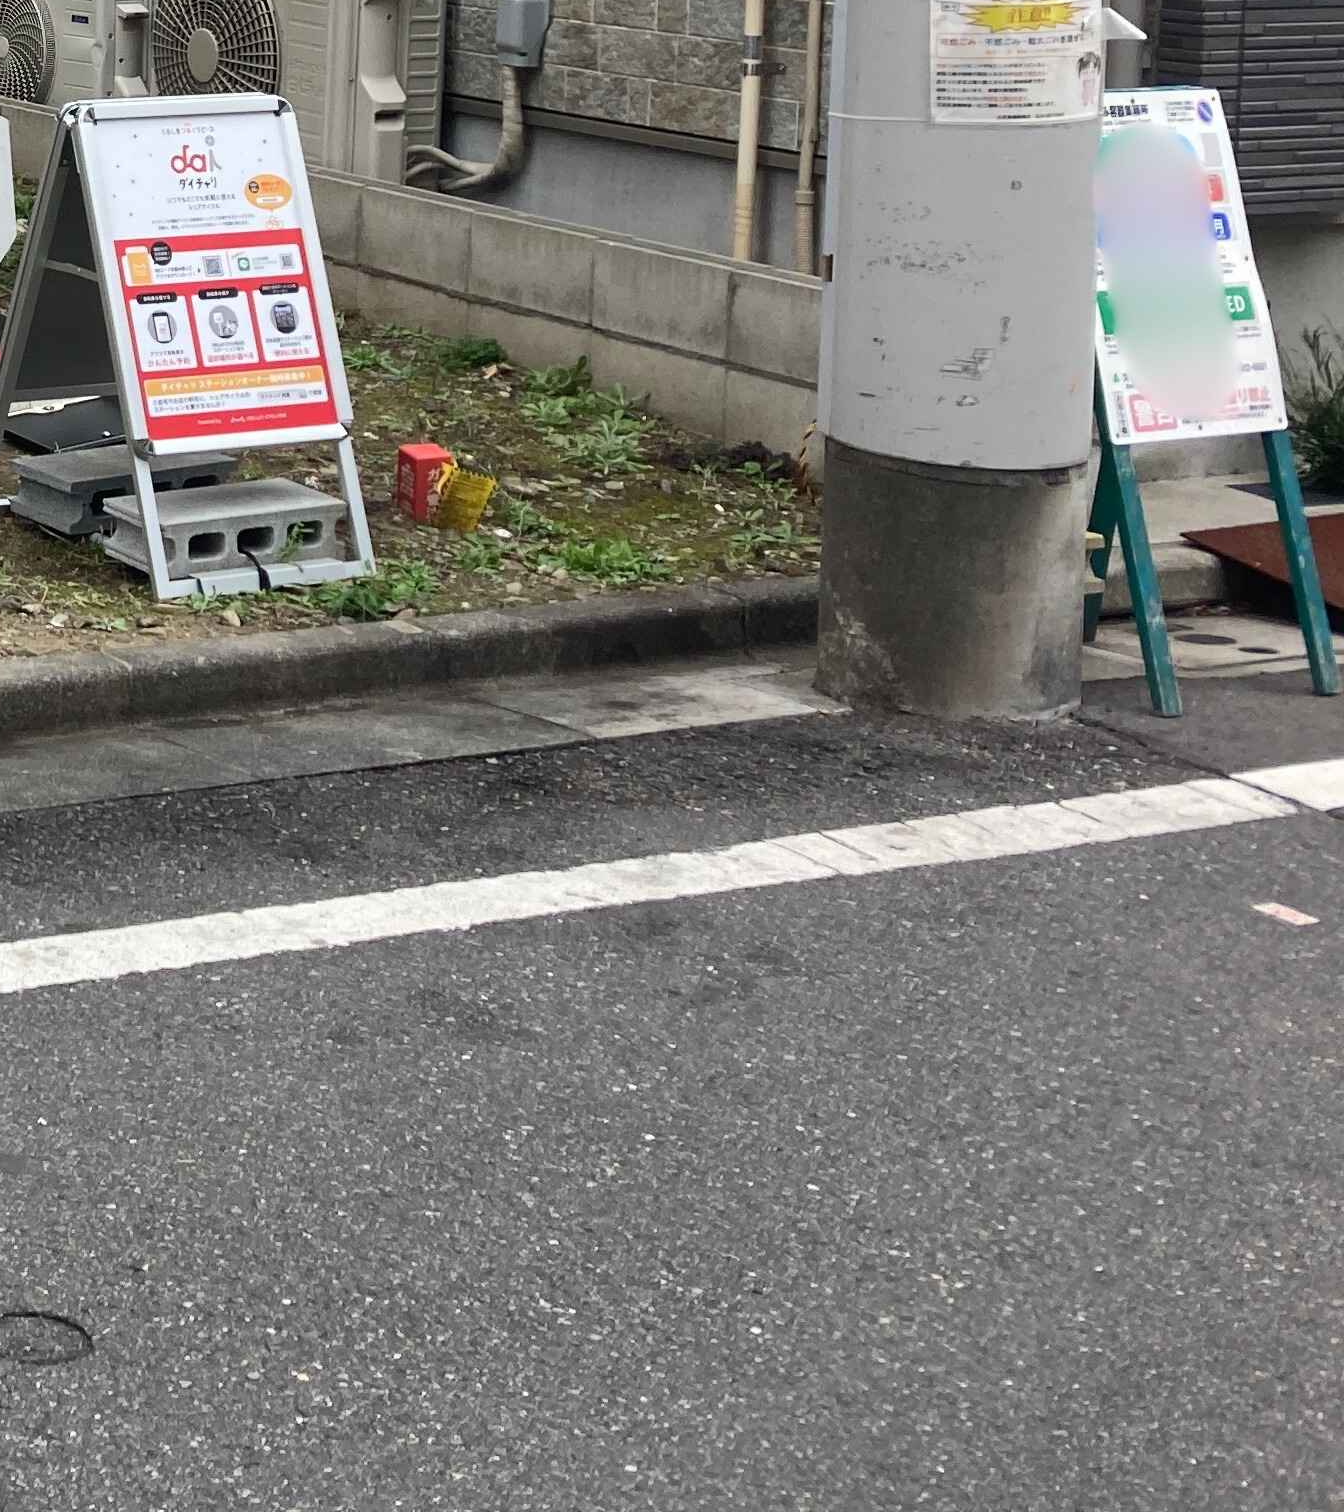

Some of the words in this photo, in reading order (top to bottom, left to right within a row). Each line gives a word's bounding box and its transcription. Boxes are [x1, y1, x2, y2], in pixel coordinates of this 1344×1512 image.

[179, 176, 217, 190] ダイチャリ
